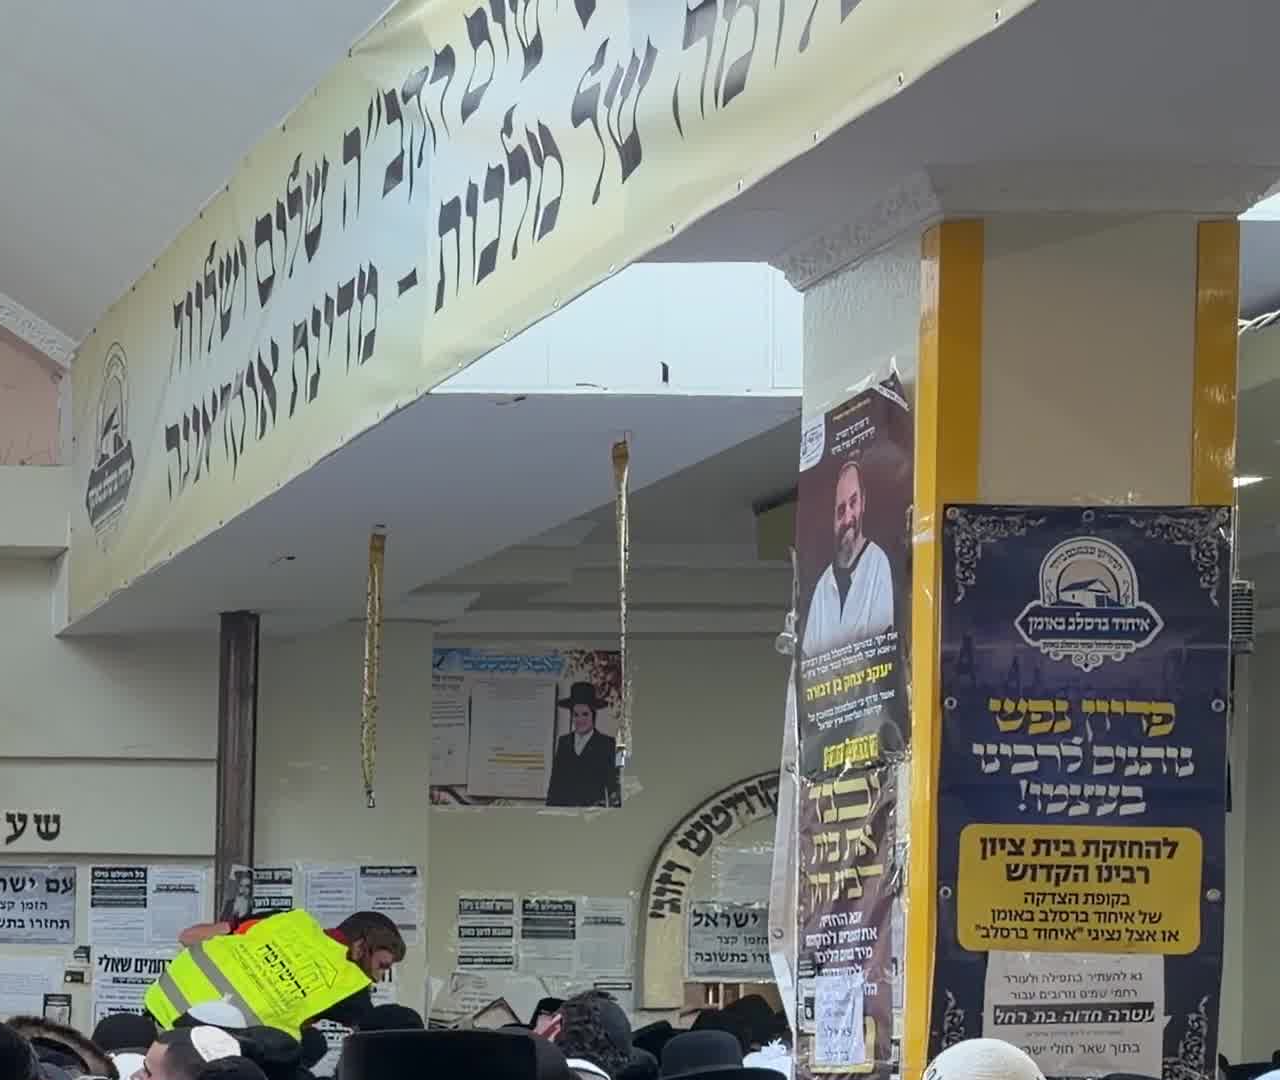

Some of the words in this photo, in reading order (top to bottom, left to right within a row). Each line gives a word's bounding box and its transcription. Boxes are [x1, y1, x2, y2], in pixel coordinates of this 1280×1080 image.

[434, 103, 566, 313] מלכות
[253, 150, 330, 309] שלום
[289, 260, 379, 419] מדינת
[1027, 616, 1066, 635] באומן
[1067, 611, 1110, 632] ברסלב
[1111, 616, 1151, 632] איחוד
[988, 697, 1073, 735] נפש
[1081, 698, 1176, 742] פדיון
[972, 735, 1084, 775] לרבינו
[1092, 745, 1195, 777] נותנים
[979, 836, 1026, 862] ציון
[1030, 838, 1078, 858] בית
[1082, 837, 1180, 863] להחזקת
[1004, 862, 1090, 887] הקדוש
[1096, 864, 1151, 885] רבינו
[44, 876, 75, 894] עם
[19, 900, 49, 912] הזמן
[1023, 890, 1080, 907] הצדקה
[1083, 891, 1131, 907] בקופת
[30, 918, 71, 931] תחזרו
[692, 908, 759, 929] ישראל
[990, 907, 1035, 926] באומן
[1040, 907, 1090, 924] ברסלב
[1093, 910, 1137, 925] איחוד
[1138, 909, 1163, 925] של
[1087, 927, 1123, 942] נציגי
[1126, 926, 1160, 943] אצל
[1162, 929, 1180, 943] או
[694, 951, 749, 964] בתשובה
[1129, 971, 1144, 983] נא
[1106, 1006, 1155, 1024] עטרה
